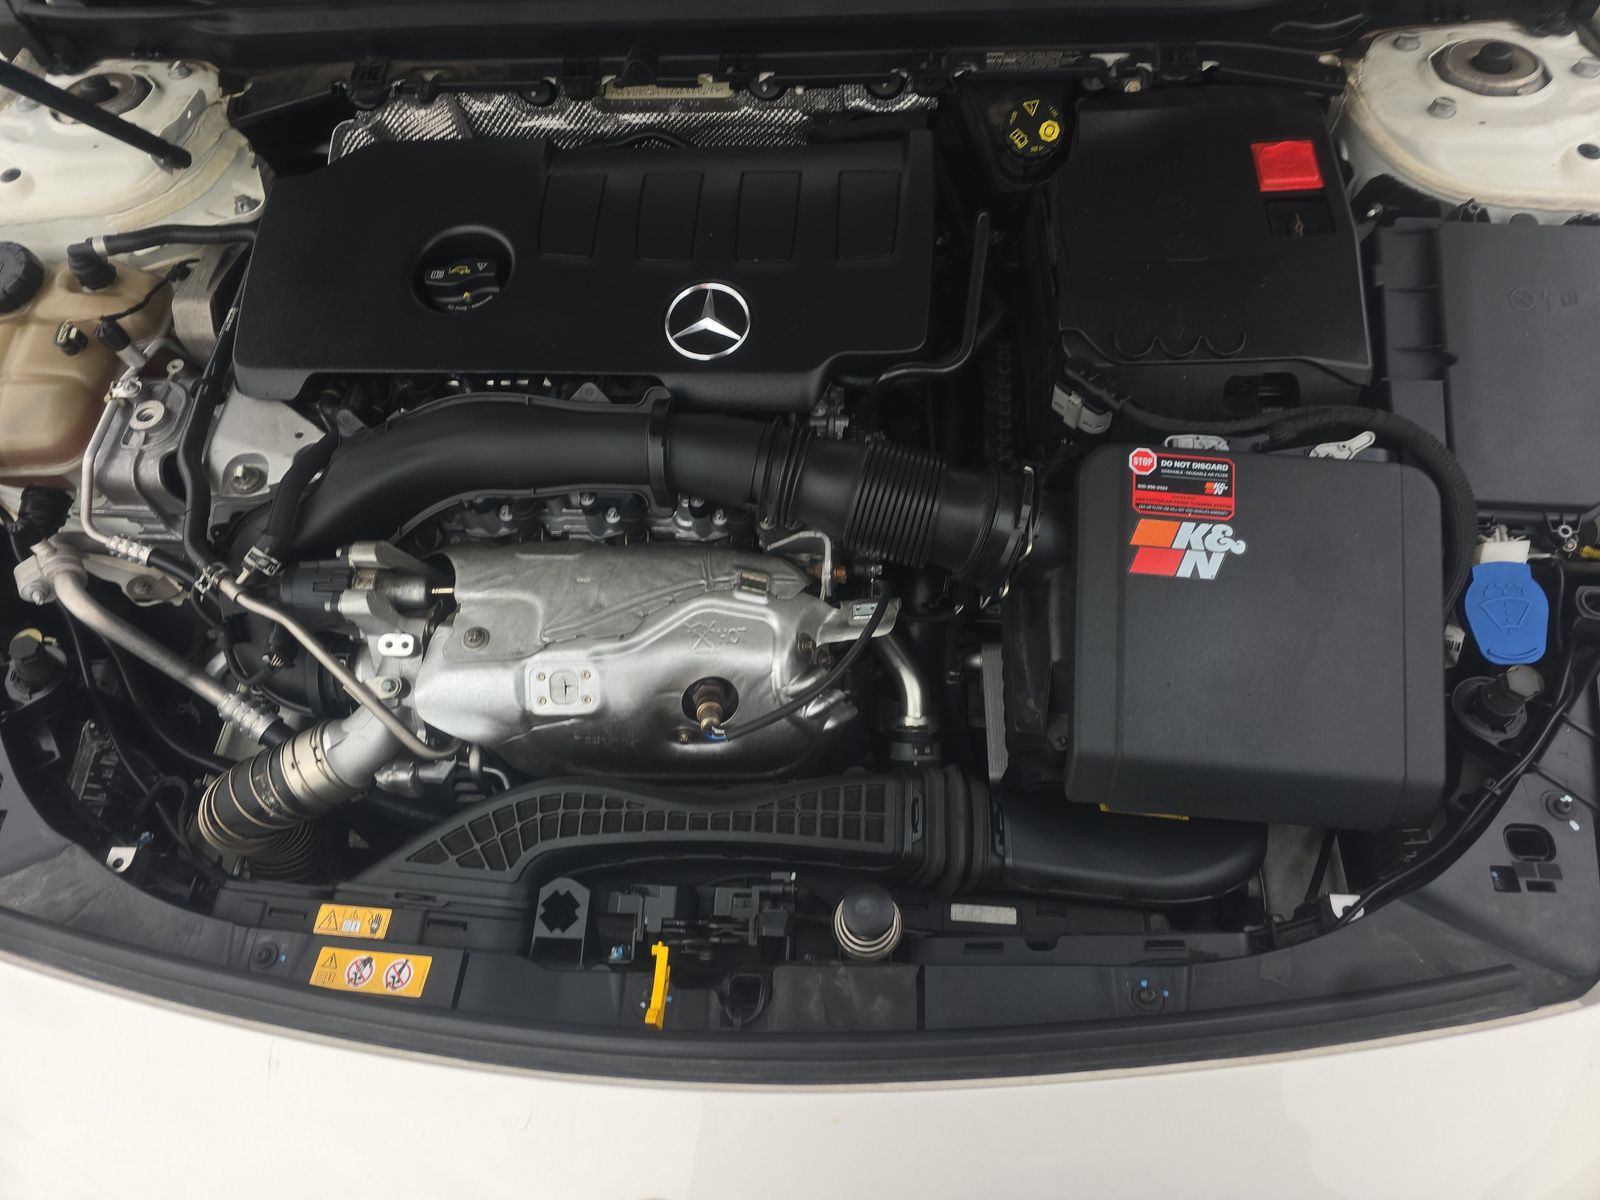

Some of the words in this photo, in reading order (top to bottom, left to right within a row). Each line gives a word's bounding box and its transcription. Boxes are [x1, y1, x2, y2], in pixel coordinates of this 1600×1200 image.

[1133, 456, 1153, 467] STOP
[1161, 459, 1173, 468] DO
[1174, 460, 1191, 469] NOT
[1191, 462, 1229, 472] DISCARD
